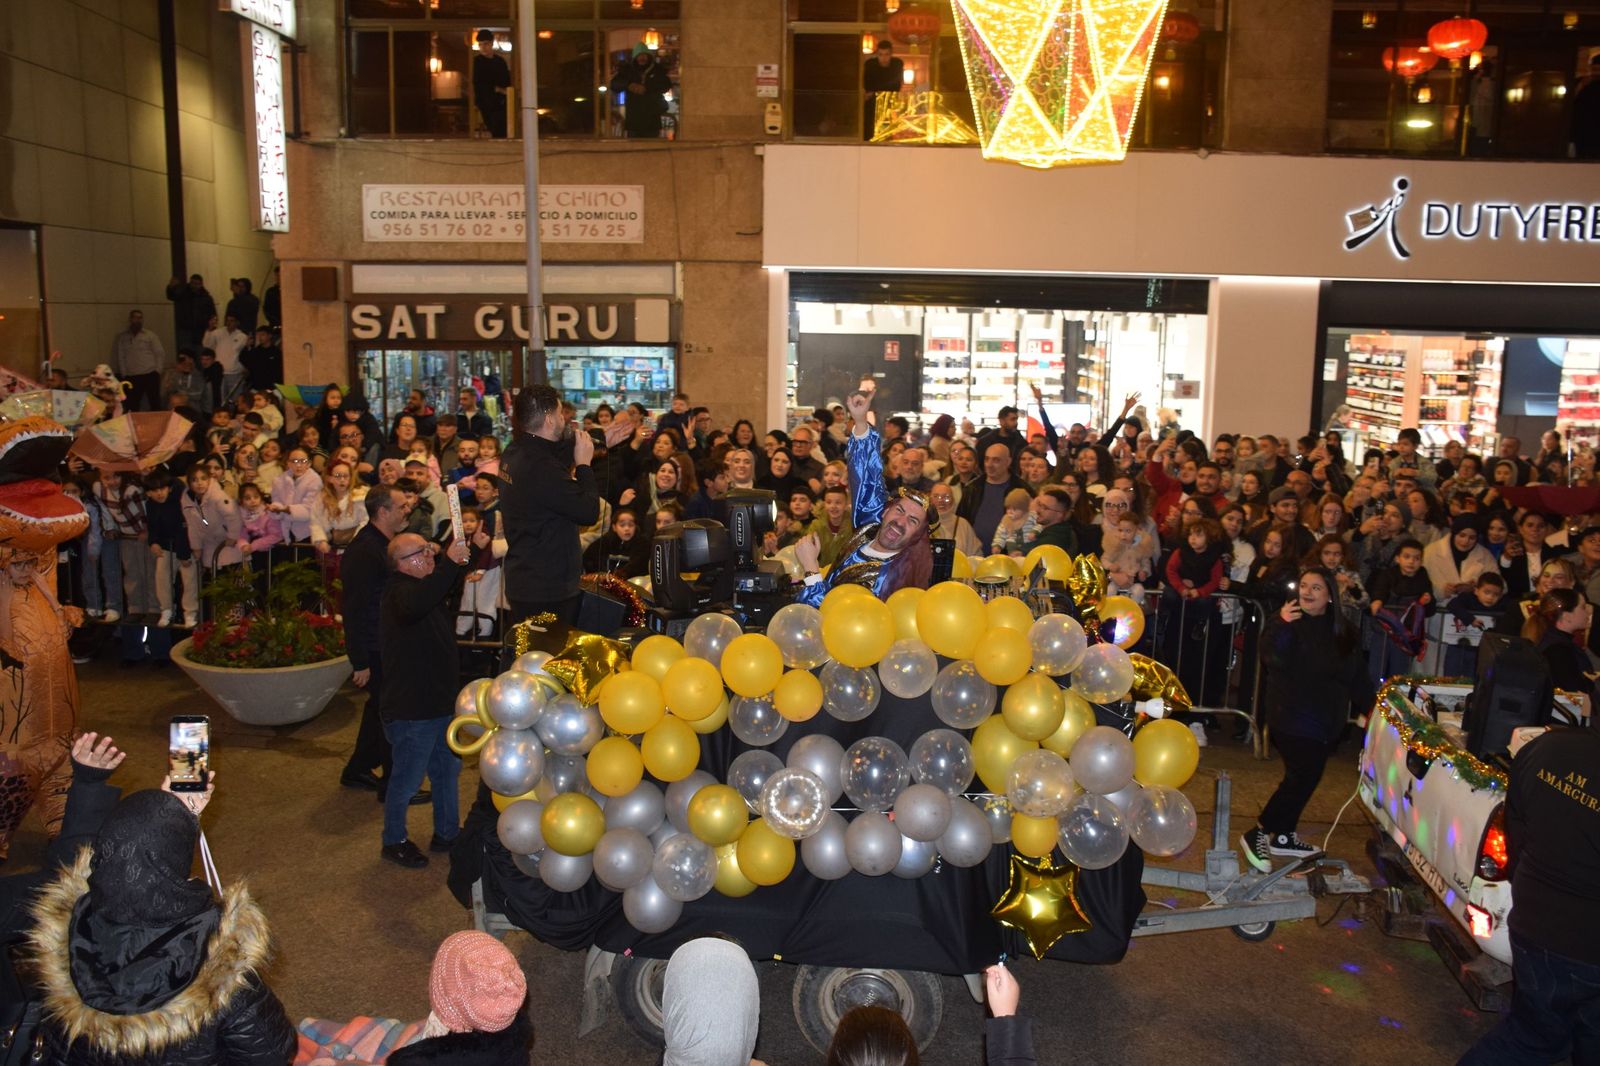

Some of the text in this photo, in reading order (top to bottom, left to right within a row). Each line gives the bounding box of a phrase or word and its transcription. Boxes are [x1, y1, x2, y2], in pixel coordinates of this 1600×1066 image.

[380, 190, 627, 208] RESTAURANE CHINO
[370, 210, 417, 220] COMIDA
[420, 210, 450, 220] PARA
[454, 210, 496, 220] LLEVAR
[507, 210, 560, 220] SERCIO
[563, 211, 572, 220] A
[575, 211, 638, 221] DOMICILIO
[382, 223, 413, 237] 956
[419, 223, 439, 237] 51
[446, 223, 466, 237] 76
[472, 223, 493, 237] 02
[552, 223, 571, 237] 51
[579, 223, 599, 237] 76
[606, 224, 626, 237] 25
[351, 304, 619, 340] SAT GURU
[1565, 771, 1587, 788] AM
